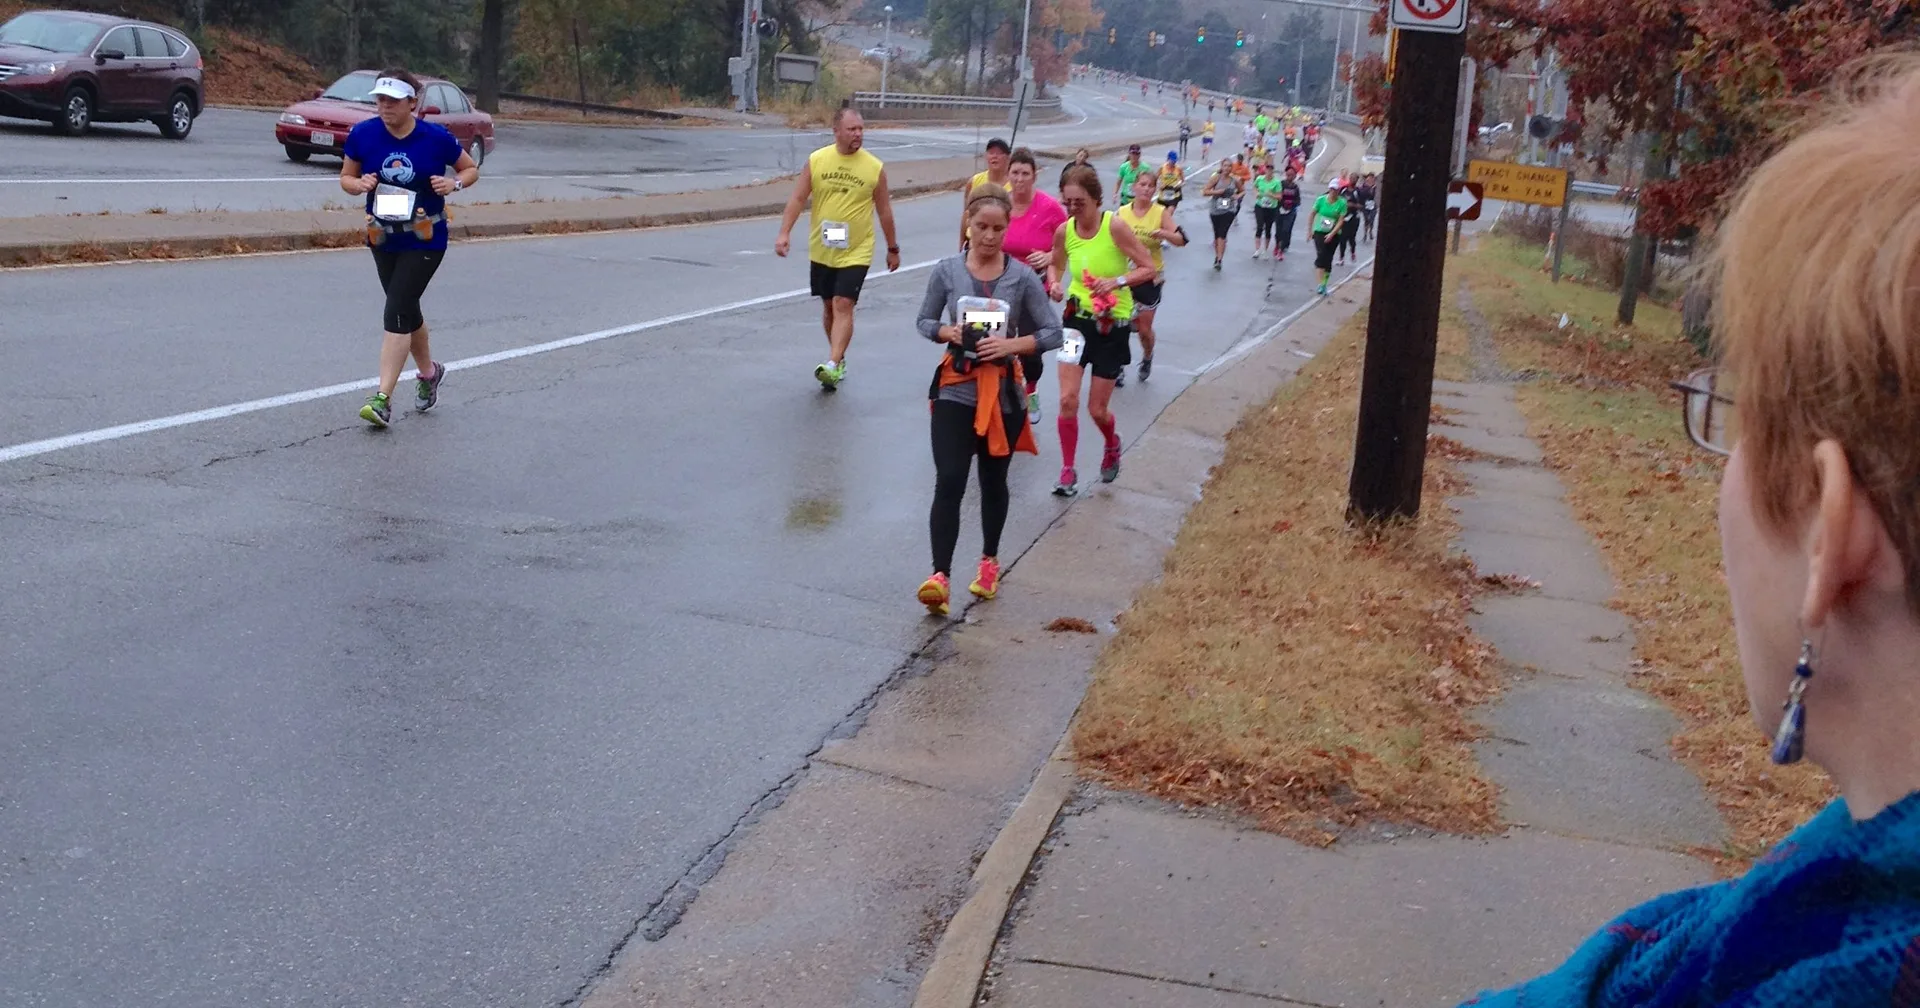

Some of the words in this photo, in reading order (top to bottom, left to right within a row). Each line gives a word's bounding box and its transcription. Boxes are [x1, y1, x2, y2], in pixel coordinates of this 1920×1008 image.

[821, 171, 866, 187] MARATHON
[1477, 166, 1510, 178] EXACT
[1516, 170, 1557, 184] CHANGE
